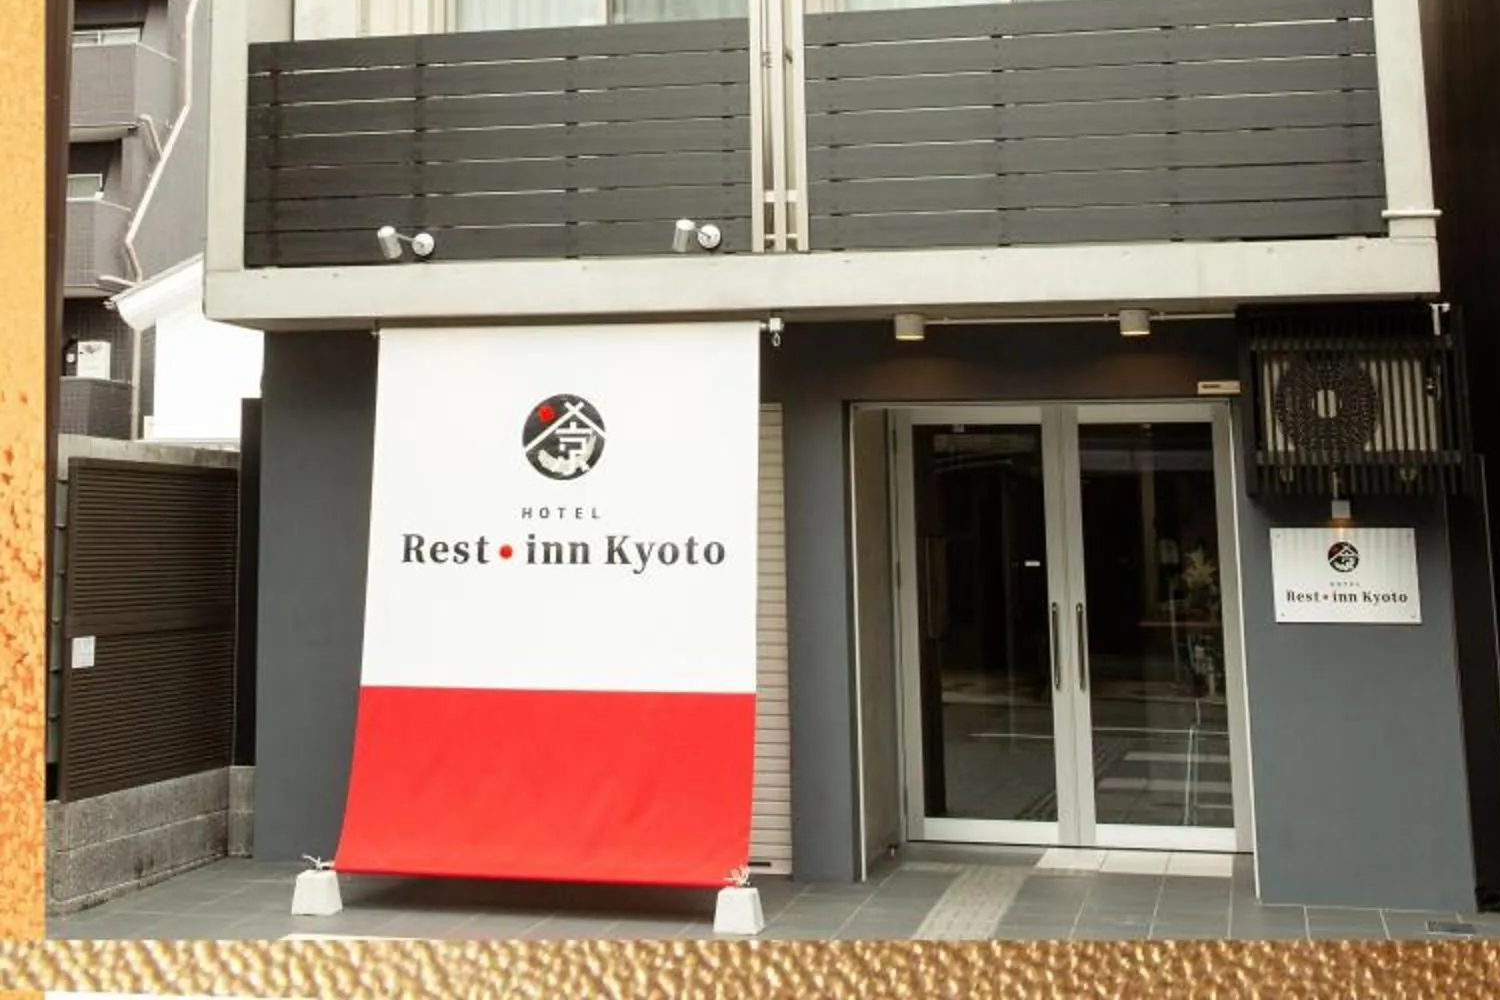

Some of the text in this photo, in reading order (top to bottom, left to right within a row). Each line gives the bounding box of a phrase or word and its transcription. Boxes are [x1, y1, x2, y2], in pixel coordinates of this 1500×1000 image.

[521, 506, 600, 520] HOTEL
[401, 533, 726, 575] Rest inn Kyoto
[1362, 591, 1409, 605] Kyoto
